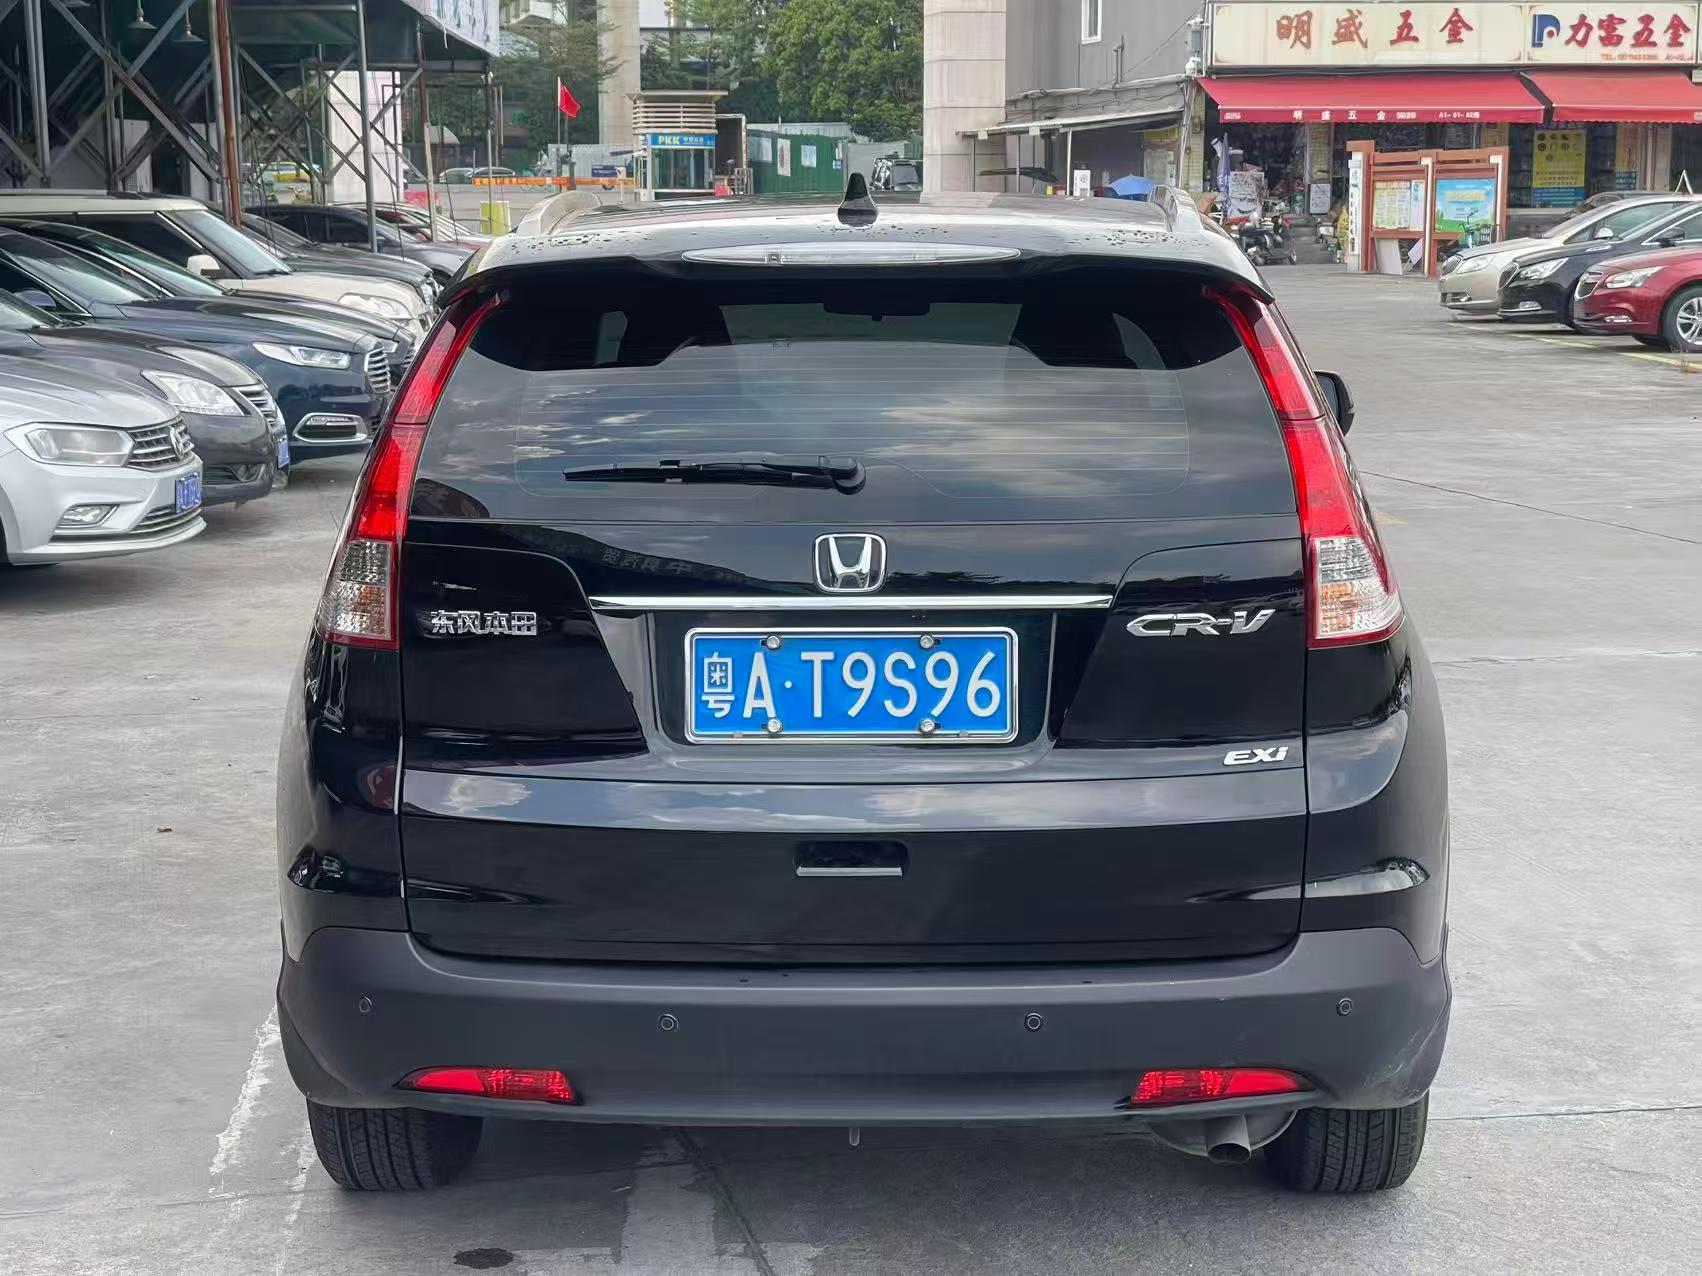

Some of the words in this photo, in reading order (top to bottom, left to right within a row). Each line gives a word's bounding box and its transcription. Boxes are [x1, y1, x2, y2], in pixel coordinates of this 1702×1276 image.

[1276, 8, 1474, 49] 明盛五金
[1564, 13, 1691, 48] 力富五金
[430, 609, 537, 635] 东风本田
[1126, 609, 1276, 637] CR-V
